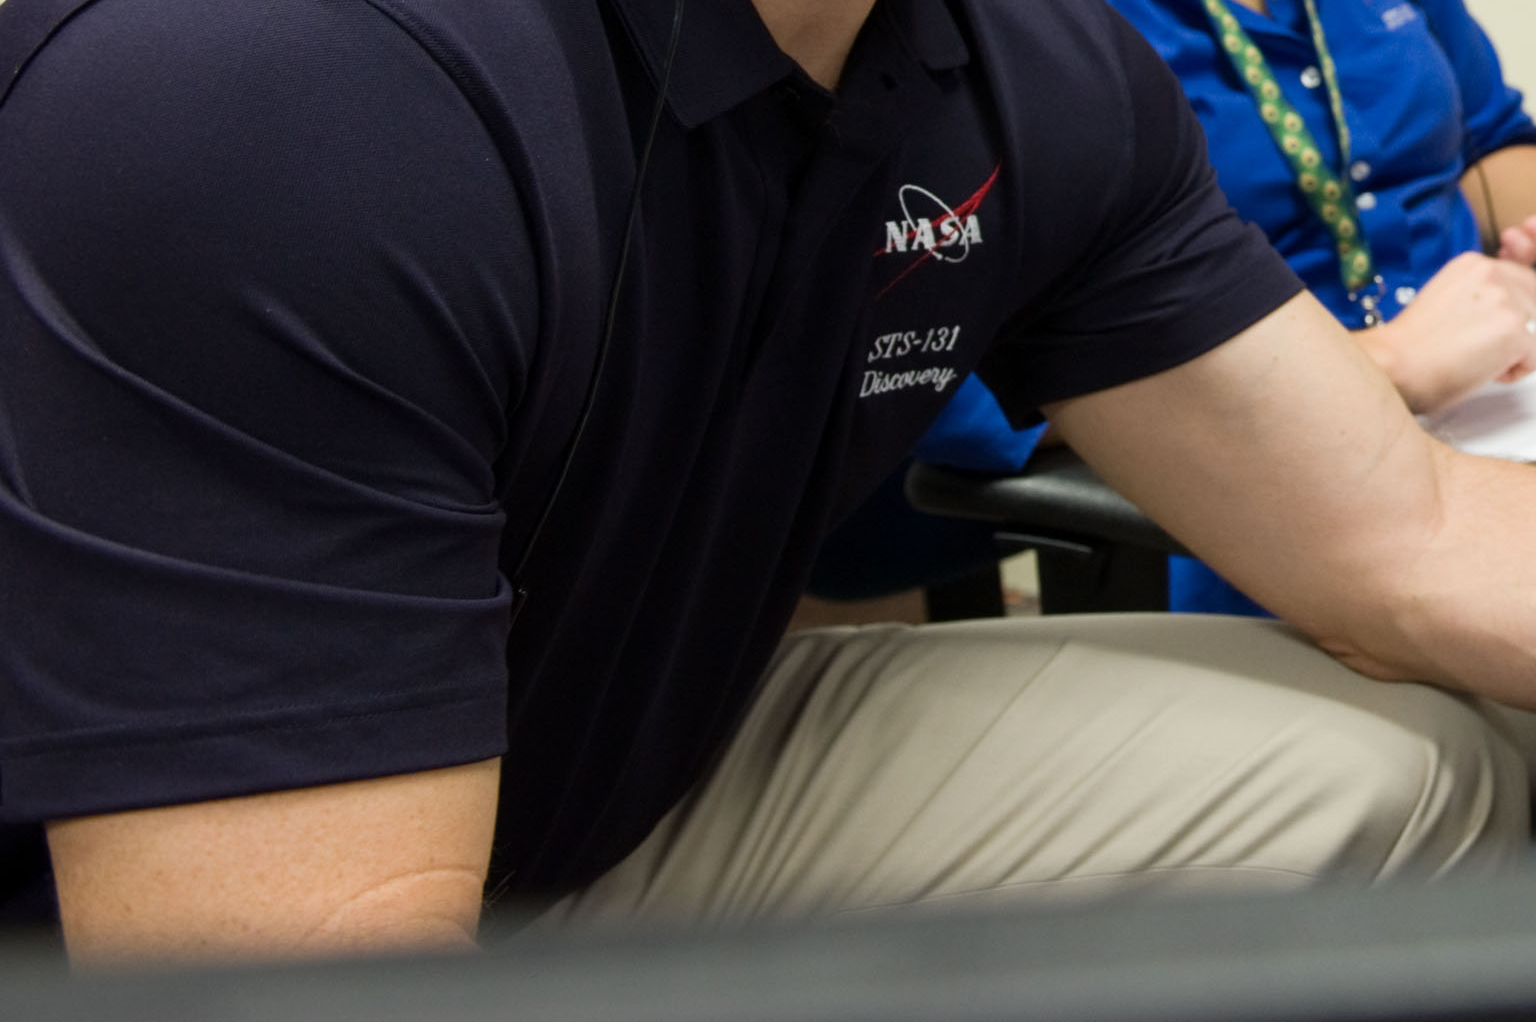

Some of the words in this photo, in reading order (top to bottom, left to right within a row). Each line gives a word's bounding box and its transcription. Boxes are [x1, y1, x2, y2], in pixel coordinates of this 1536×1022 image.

[885, 214, 983, 254] NASA
[867, 325, 961, 363] STS-131
[859, 366, 957, 398] Discovery
